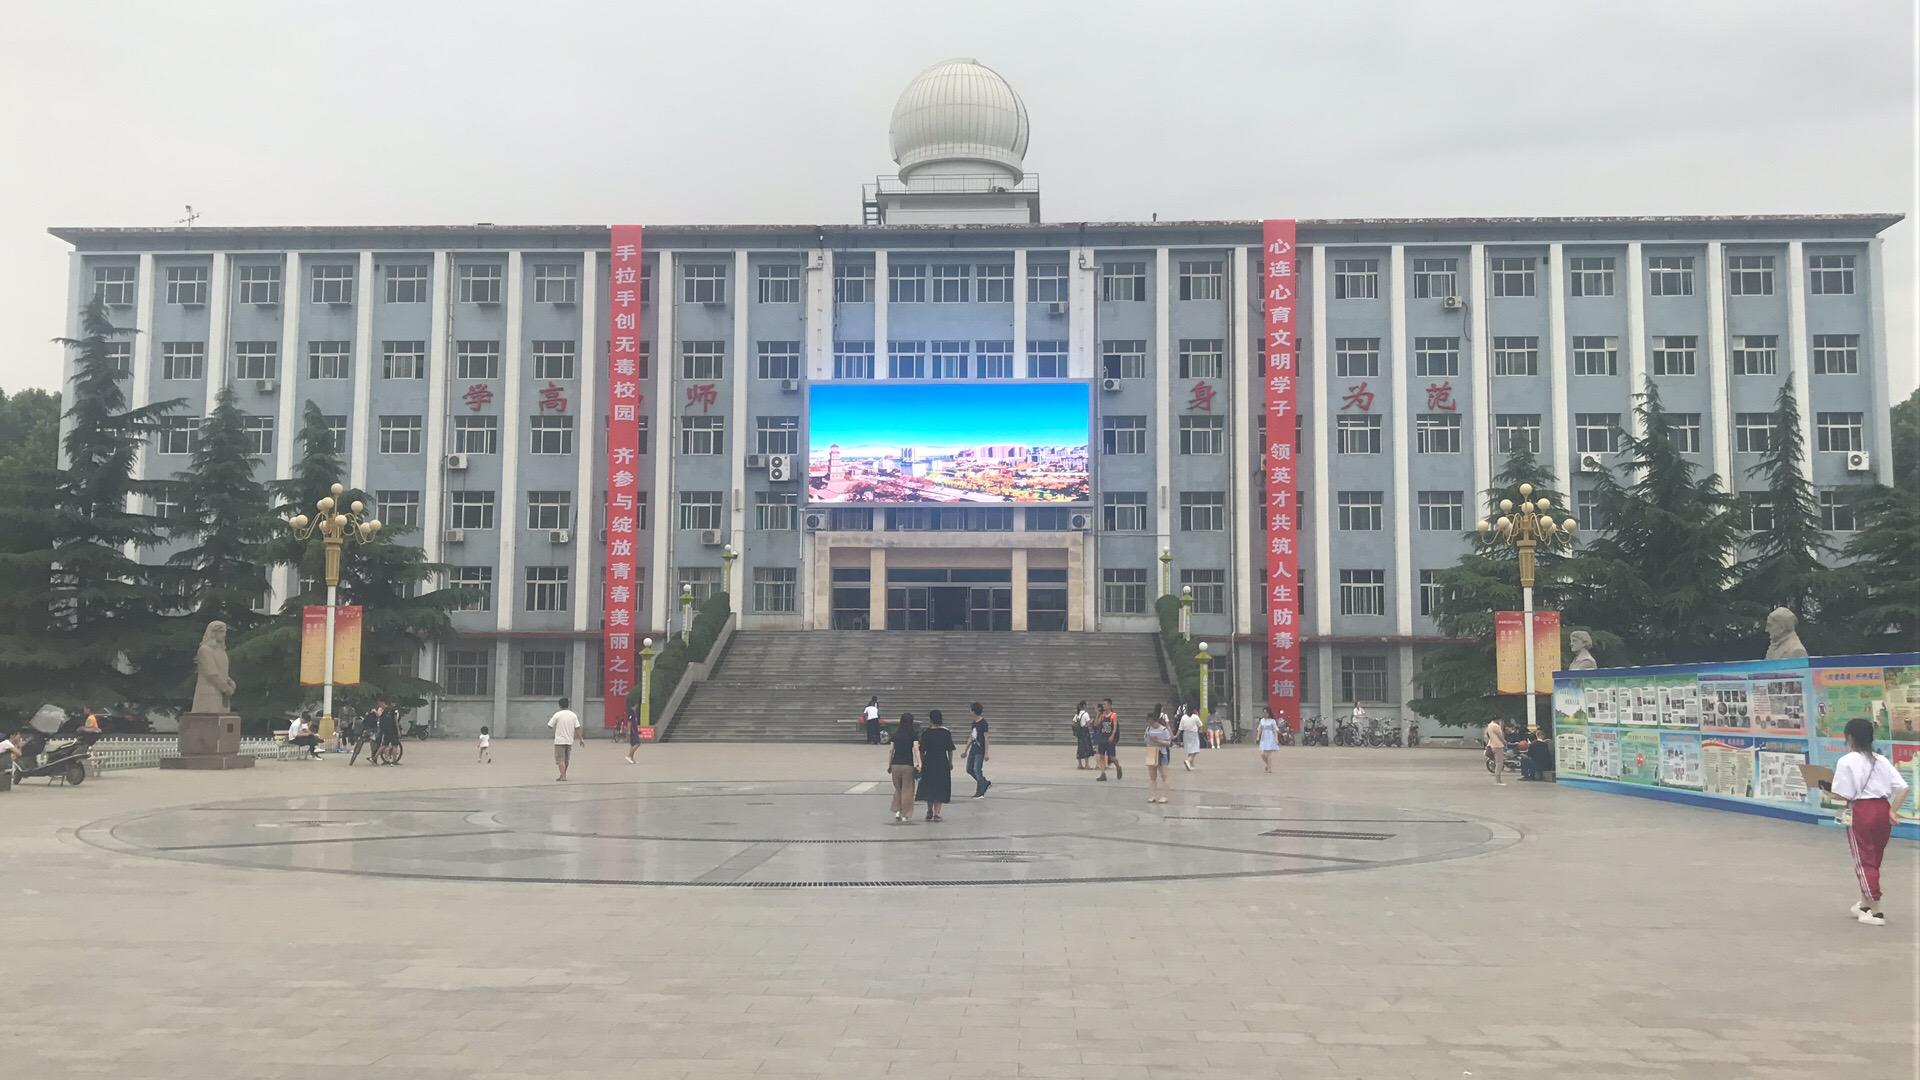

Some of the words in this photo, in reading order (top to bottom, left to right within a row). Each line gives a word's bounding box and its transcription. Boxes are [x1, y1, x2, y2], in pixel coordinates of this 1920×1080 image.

[614, 244, 637, 421] 手拉手创无毒校园
[1269, 238, 1292, 417] 心连心育文明学子
[609, 447, 634, 697] 齐参与绽放青春美丽之花
[1270, 442, 1296, 698] 领英才共筑人生防毒之墙
